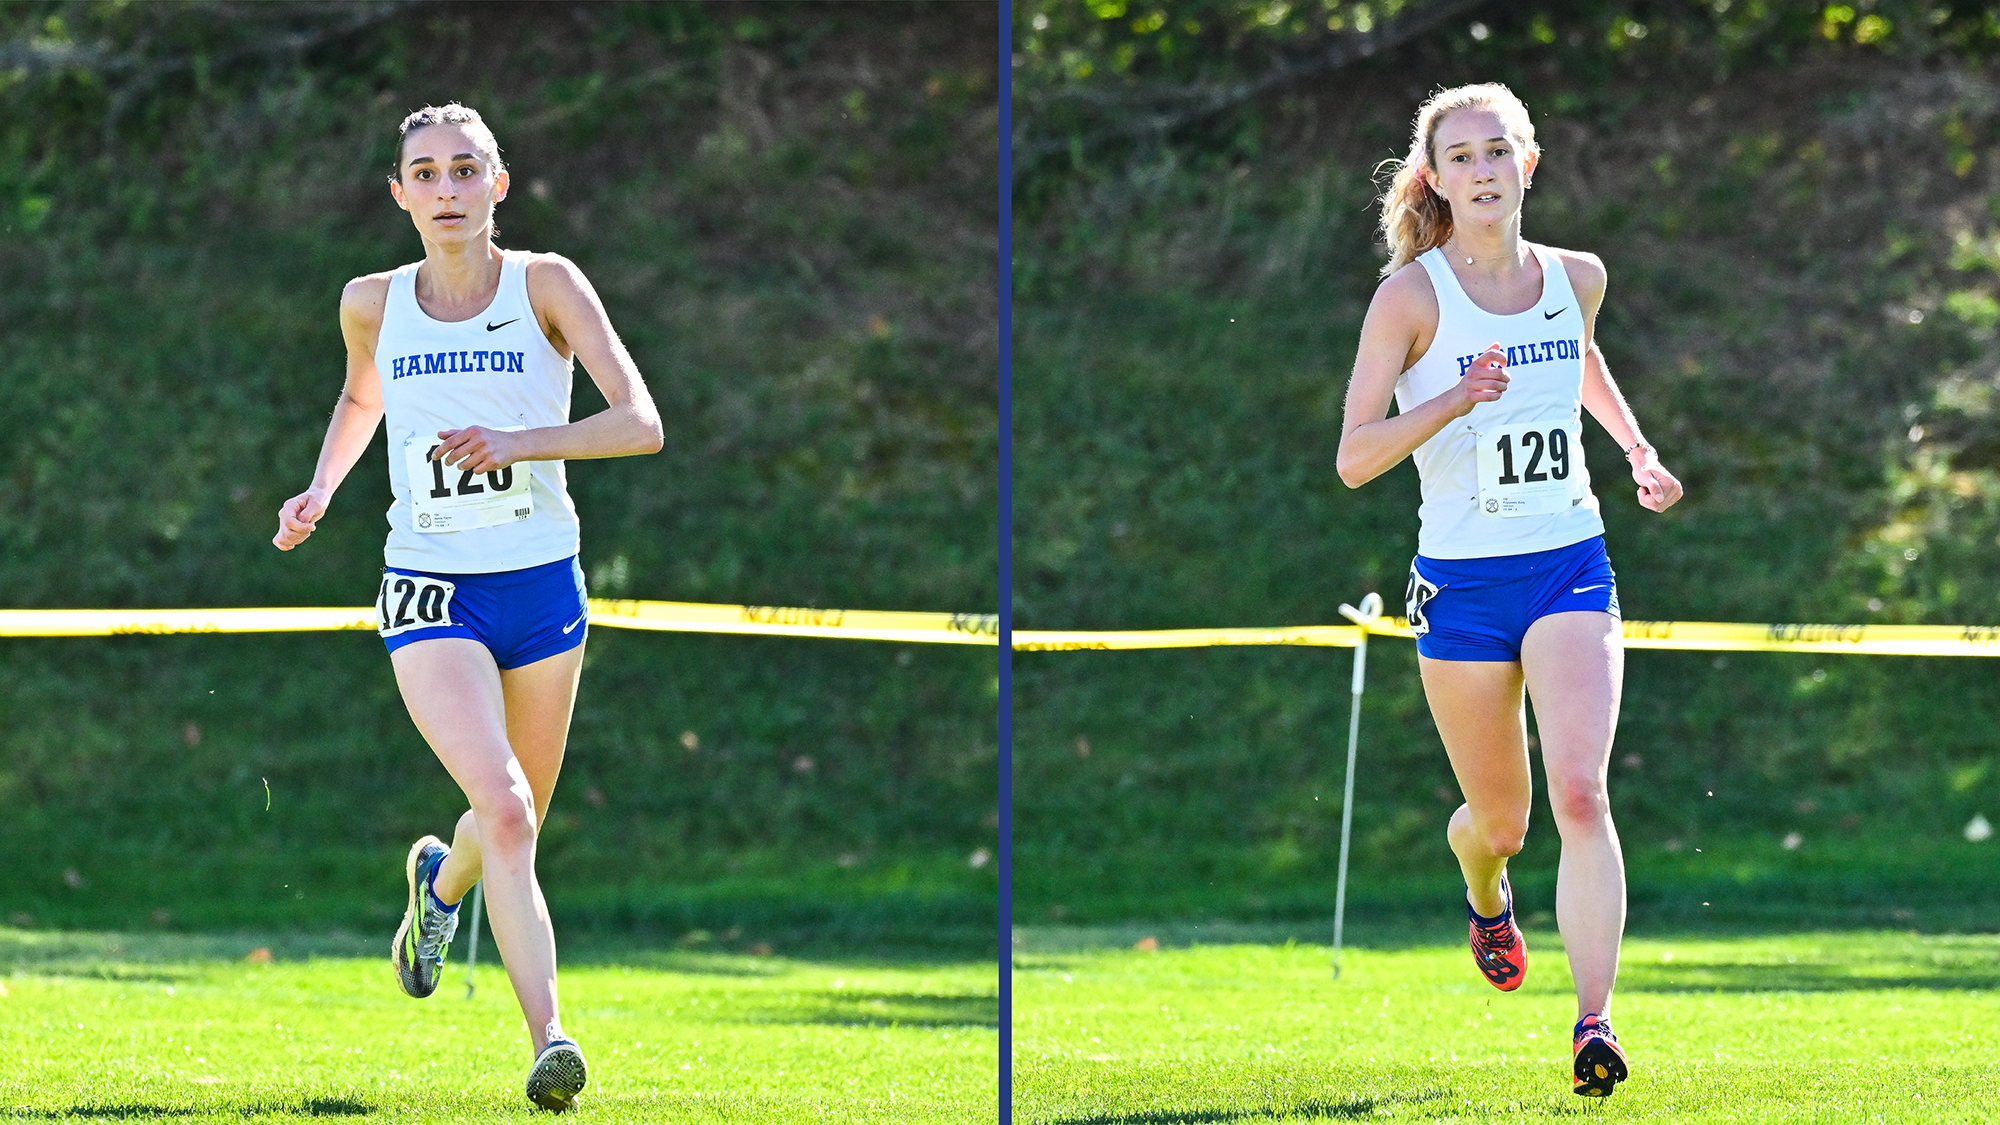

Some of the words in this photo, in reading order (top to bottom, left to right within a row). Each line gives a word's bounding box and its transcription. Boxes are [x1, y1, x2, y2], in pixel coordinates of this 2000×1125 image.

[392, 351, 524, 380] HAMILTON
[1456, 339, 1580, 377] HMILTON
[1496, 428, 1569, 485] 129
[380, 578, 446, 630] 120
